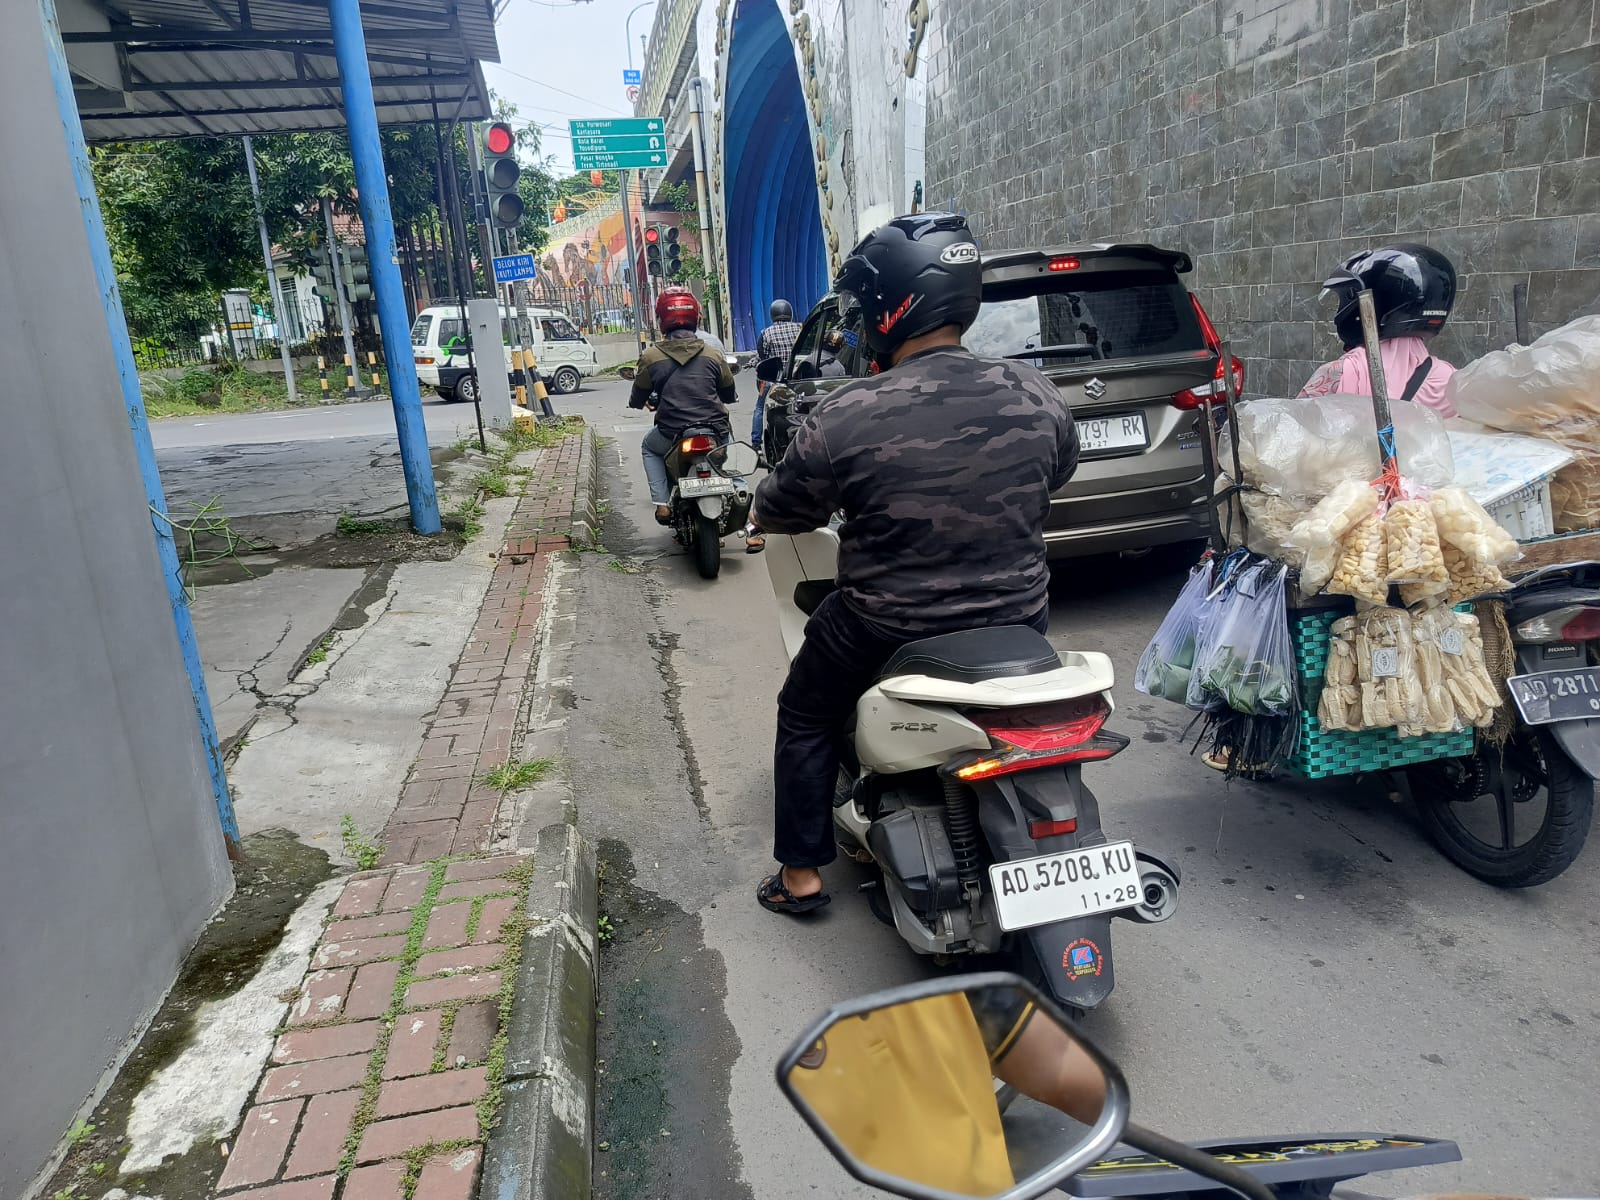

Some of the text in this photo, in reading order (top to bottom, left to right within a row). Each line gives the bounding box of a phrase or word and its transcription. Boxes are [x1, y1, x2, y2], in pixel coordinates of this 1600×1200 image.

[949, 248, 976, 258] VOG
[496, 257, 530, 268] BELOK KIRI
[496, 266, 534, 278] IKUTI LAMPU
[1122, 416, 1142, 438] RK
[1552, 674, 1599, 697] 2871
[890, 722, 938, 732] PCX
[1001, 847, 1132, 896] AD 5208 KU
